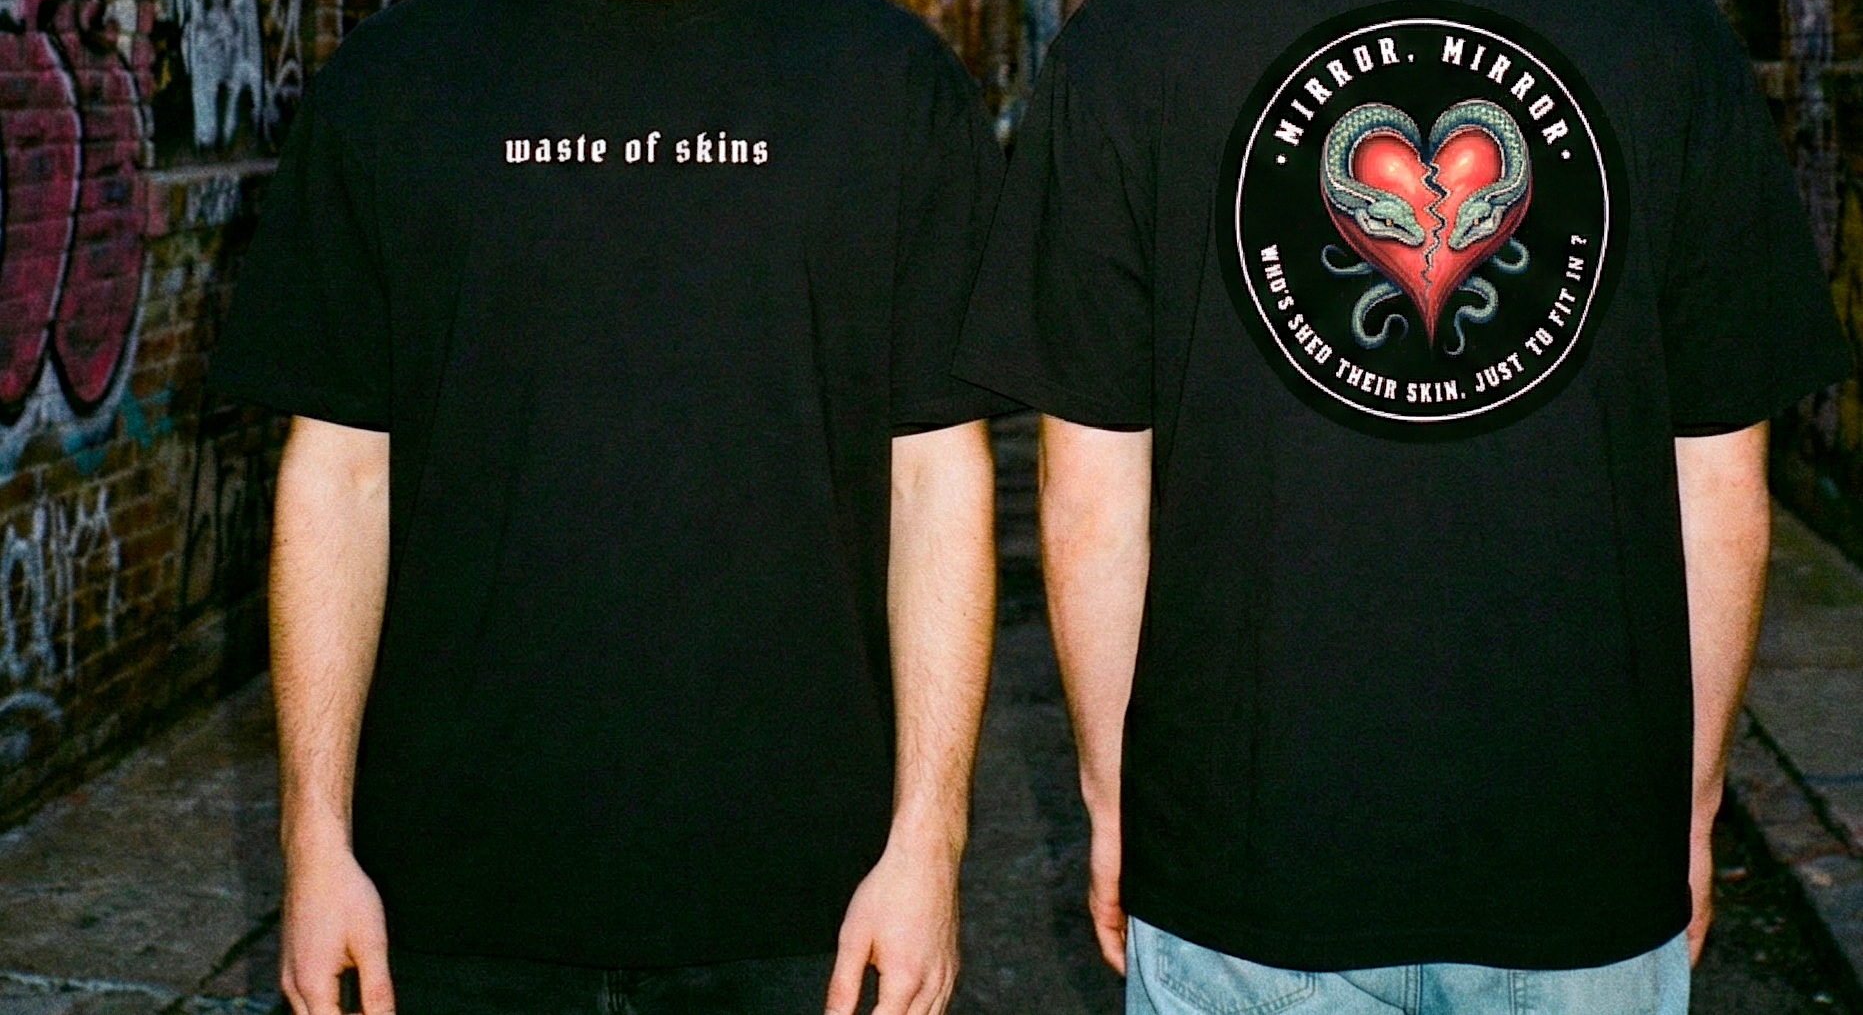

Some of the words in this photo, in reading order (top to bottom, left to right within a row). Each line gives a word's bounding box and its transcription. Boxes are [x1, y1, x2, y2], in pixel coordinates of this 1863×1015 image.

[1441, 35, 1569, 145] MIRROR
[505, 133, 607, 164] waste
[625, 130, 662, 164] of
[675, 130, 769, 165] skins
[1260, 243, 1295, 311] WHO'S
[1287, 313, 1333, 365] SHED
[1334, 357, 1397, 400] THEIR
[1475, 351, 1525, 393] JUST
[1524, 327, 1554, 356] TO
[1547, 287, 1576, 327] FIT
[1565, 255, 1586, 282] IN
